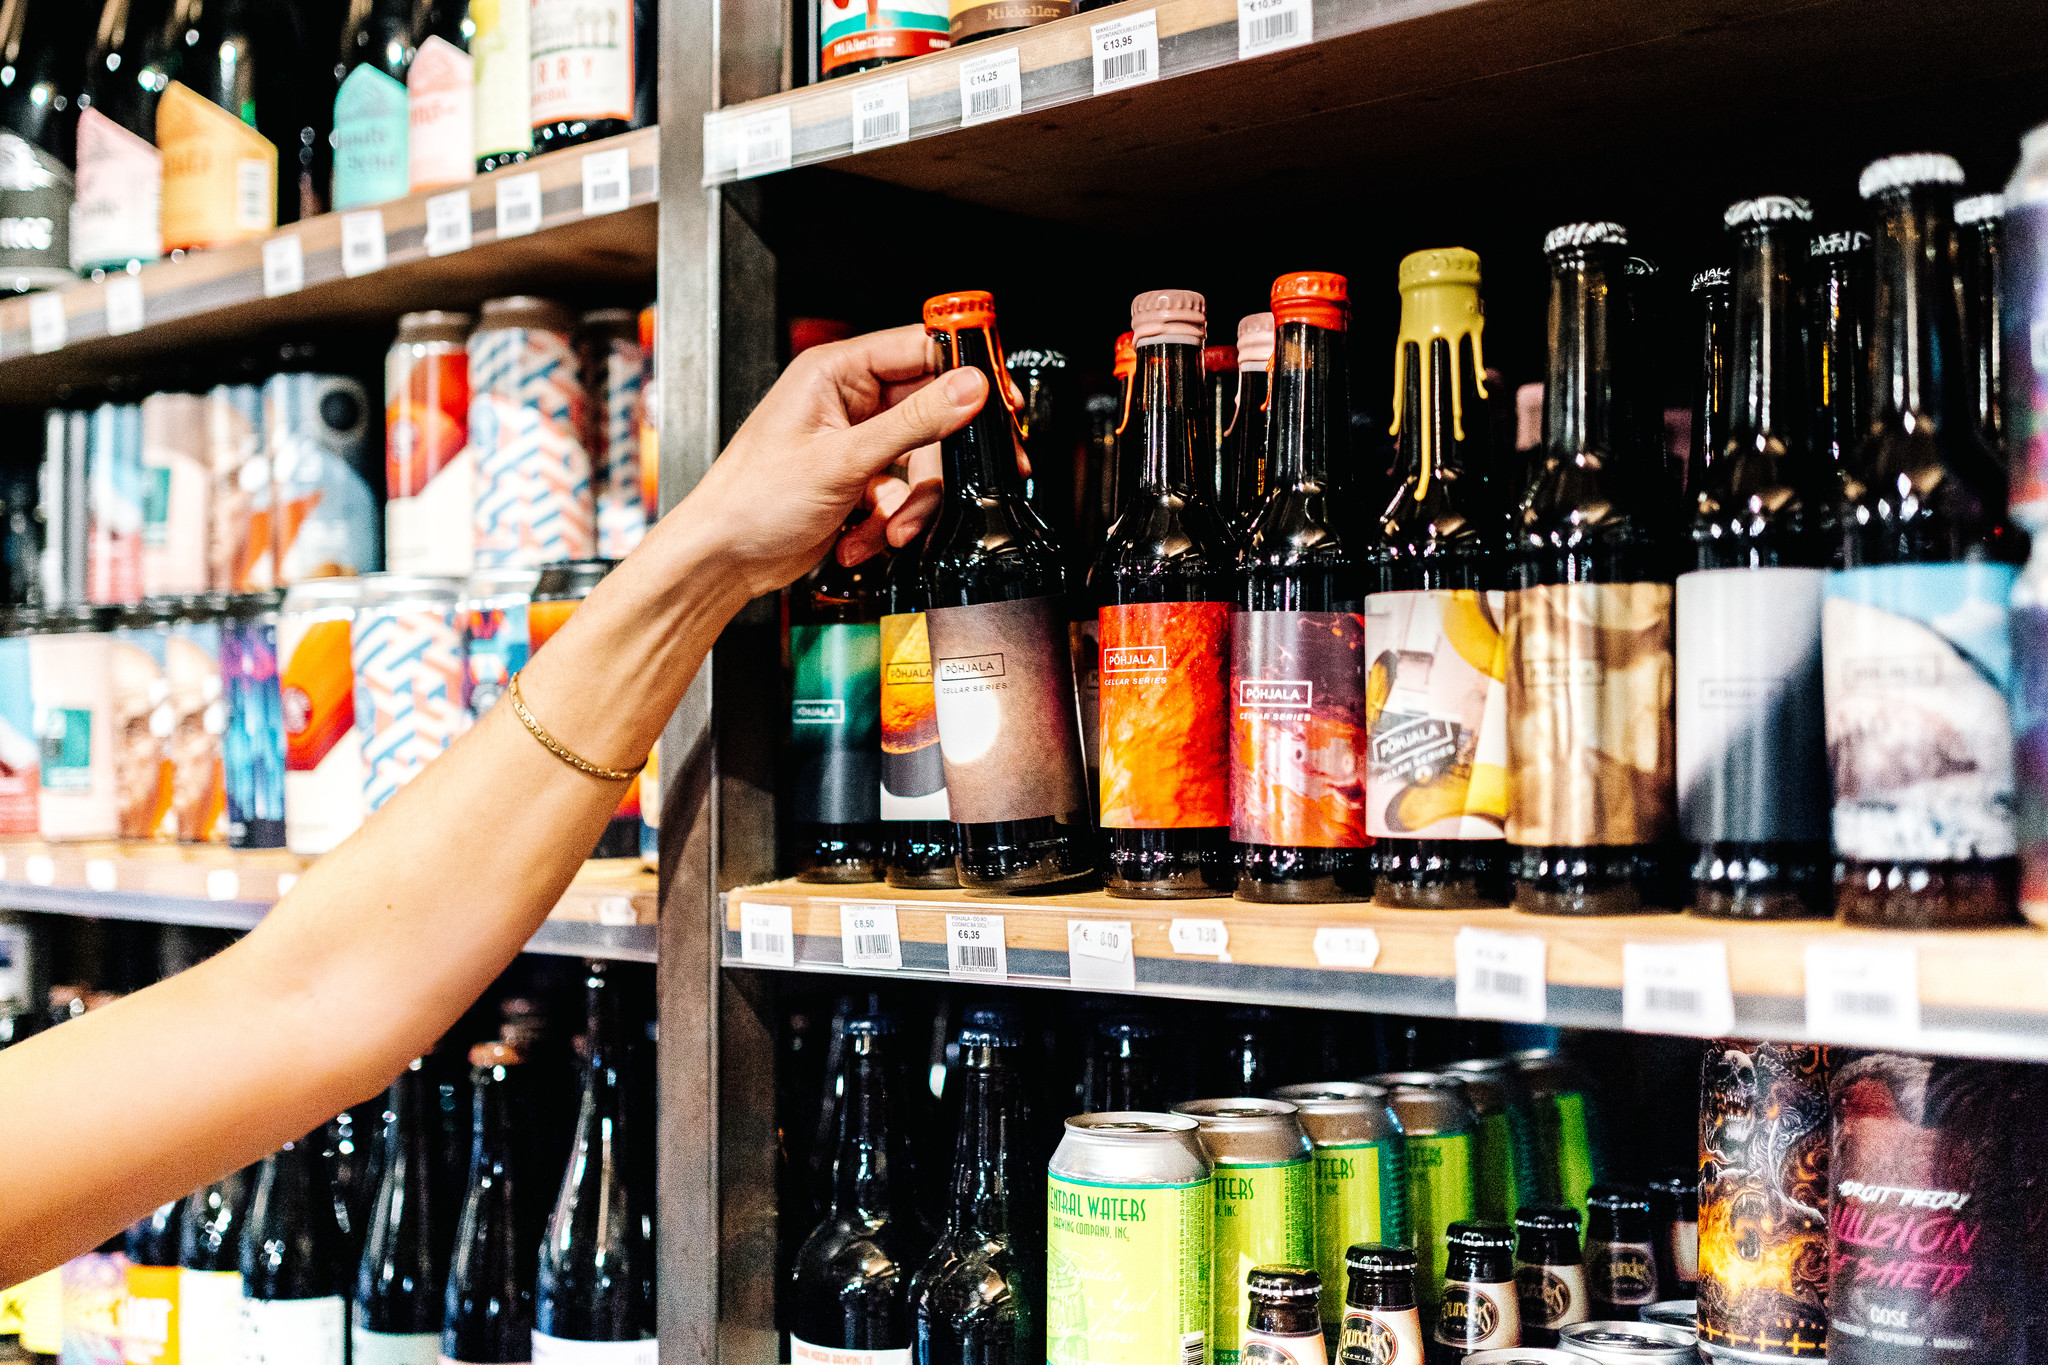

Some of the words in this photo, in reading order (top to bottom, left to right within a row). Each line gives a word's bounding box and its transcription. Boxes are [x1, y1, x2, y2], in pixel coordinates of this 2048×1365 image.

[987, 5, 1060, 20] Mikkeller
[1109, 653, 1156, 666] PÕHJALA
[945, 661, 995, 674] PÕHJALA
[942, 686, 970, 694] CELLAR
[972, 682, 1008, 692] SERIES
[1104, 678, 1130, 686] CELLAR
[1132, 677, 1167, 685] SERIES
[1246, 686, 1300, 700] PÕHJALA
[1272, 712, 1312, 722] SERIES
[958, 929, 980, 940] €6,35
[1087, 1195, 1146, 1222] WATERS
[1870, 1304, 1909, 1329] GOSE
